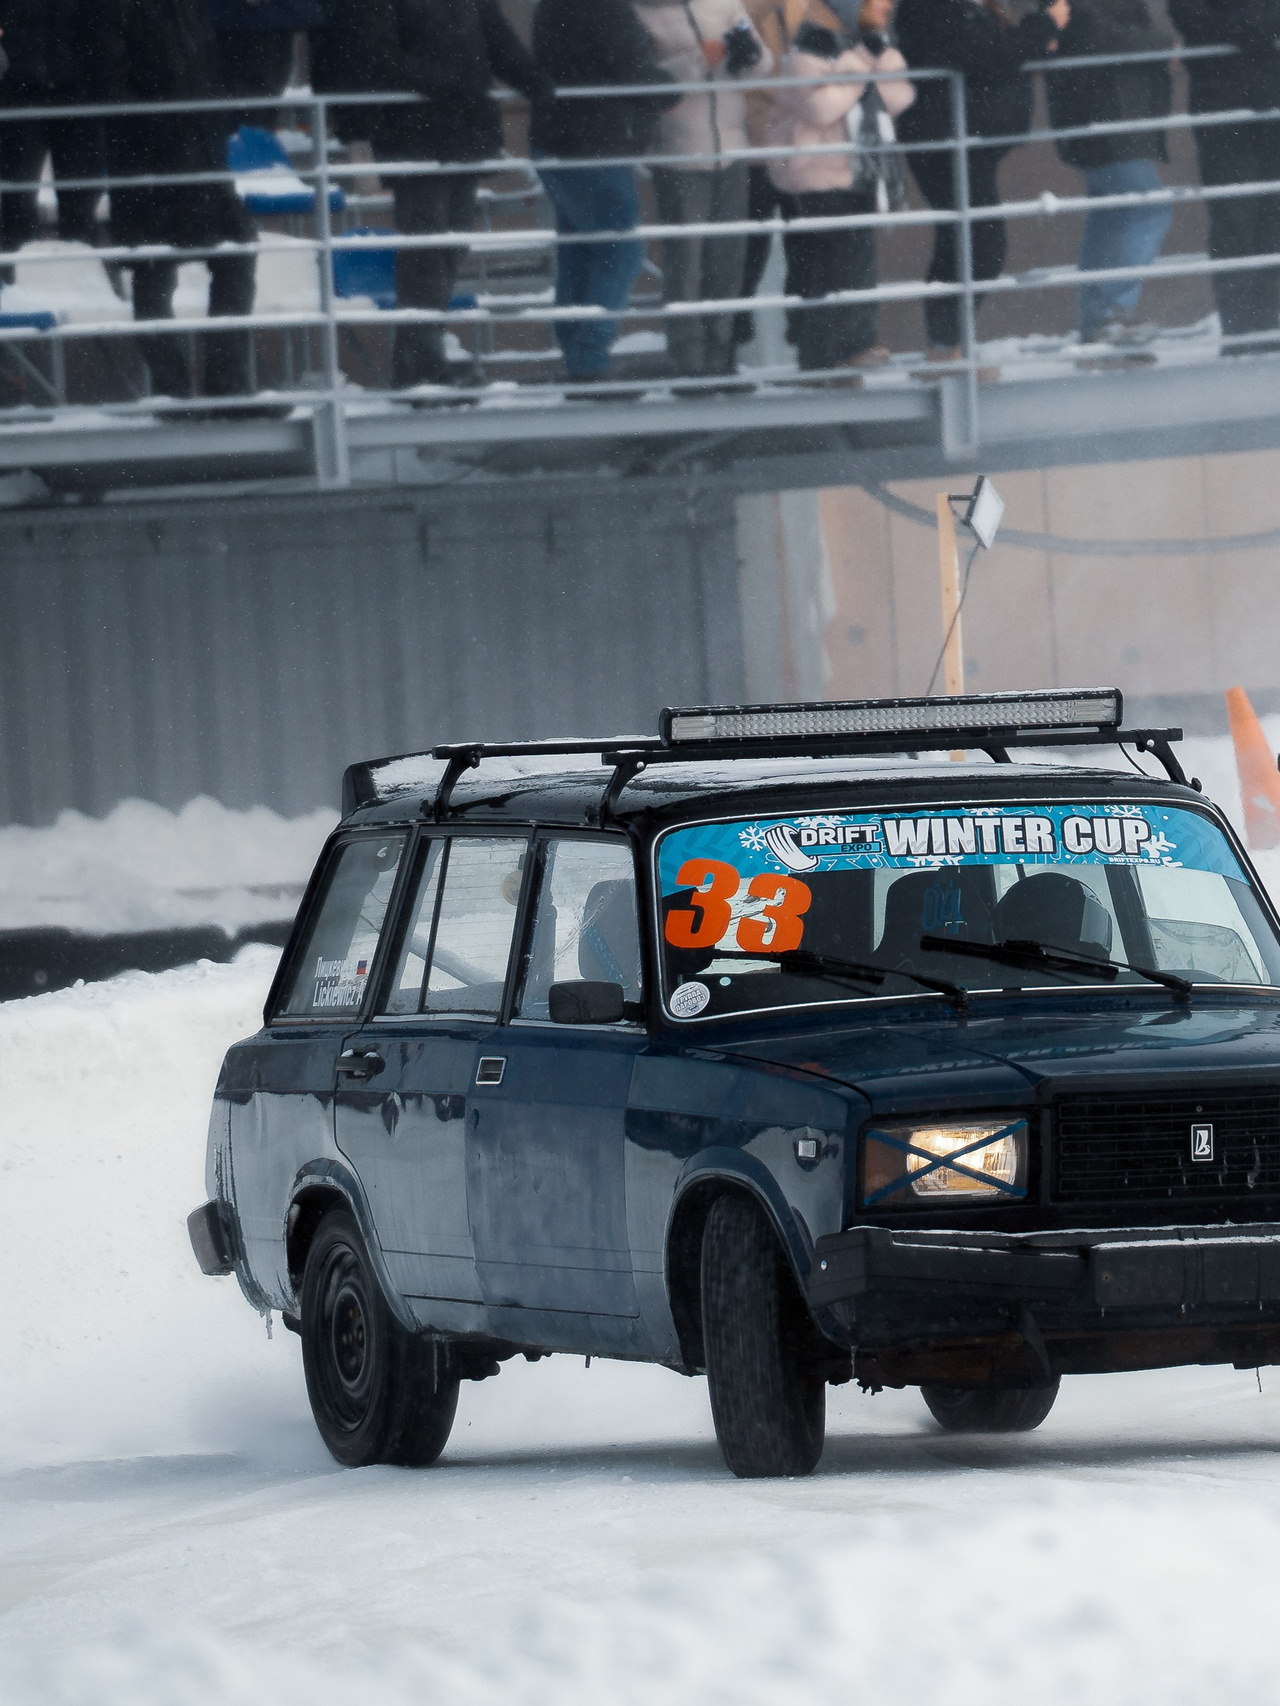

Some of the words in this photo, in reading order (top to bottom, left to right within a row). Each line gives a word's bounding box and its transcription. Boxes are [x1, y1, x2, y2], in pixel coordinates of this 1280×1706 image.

[801, 825, 877, 846] DRIFT
[841, 843, 872, 853] EXPO
[882, 816, 1055, 855] WINTER
[1063, 816, 1149, 854] CUP
[665, 858, 812, 953] 33
